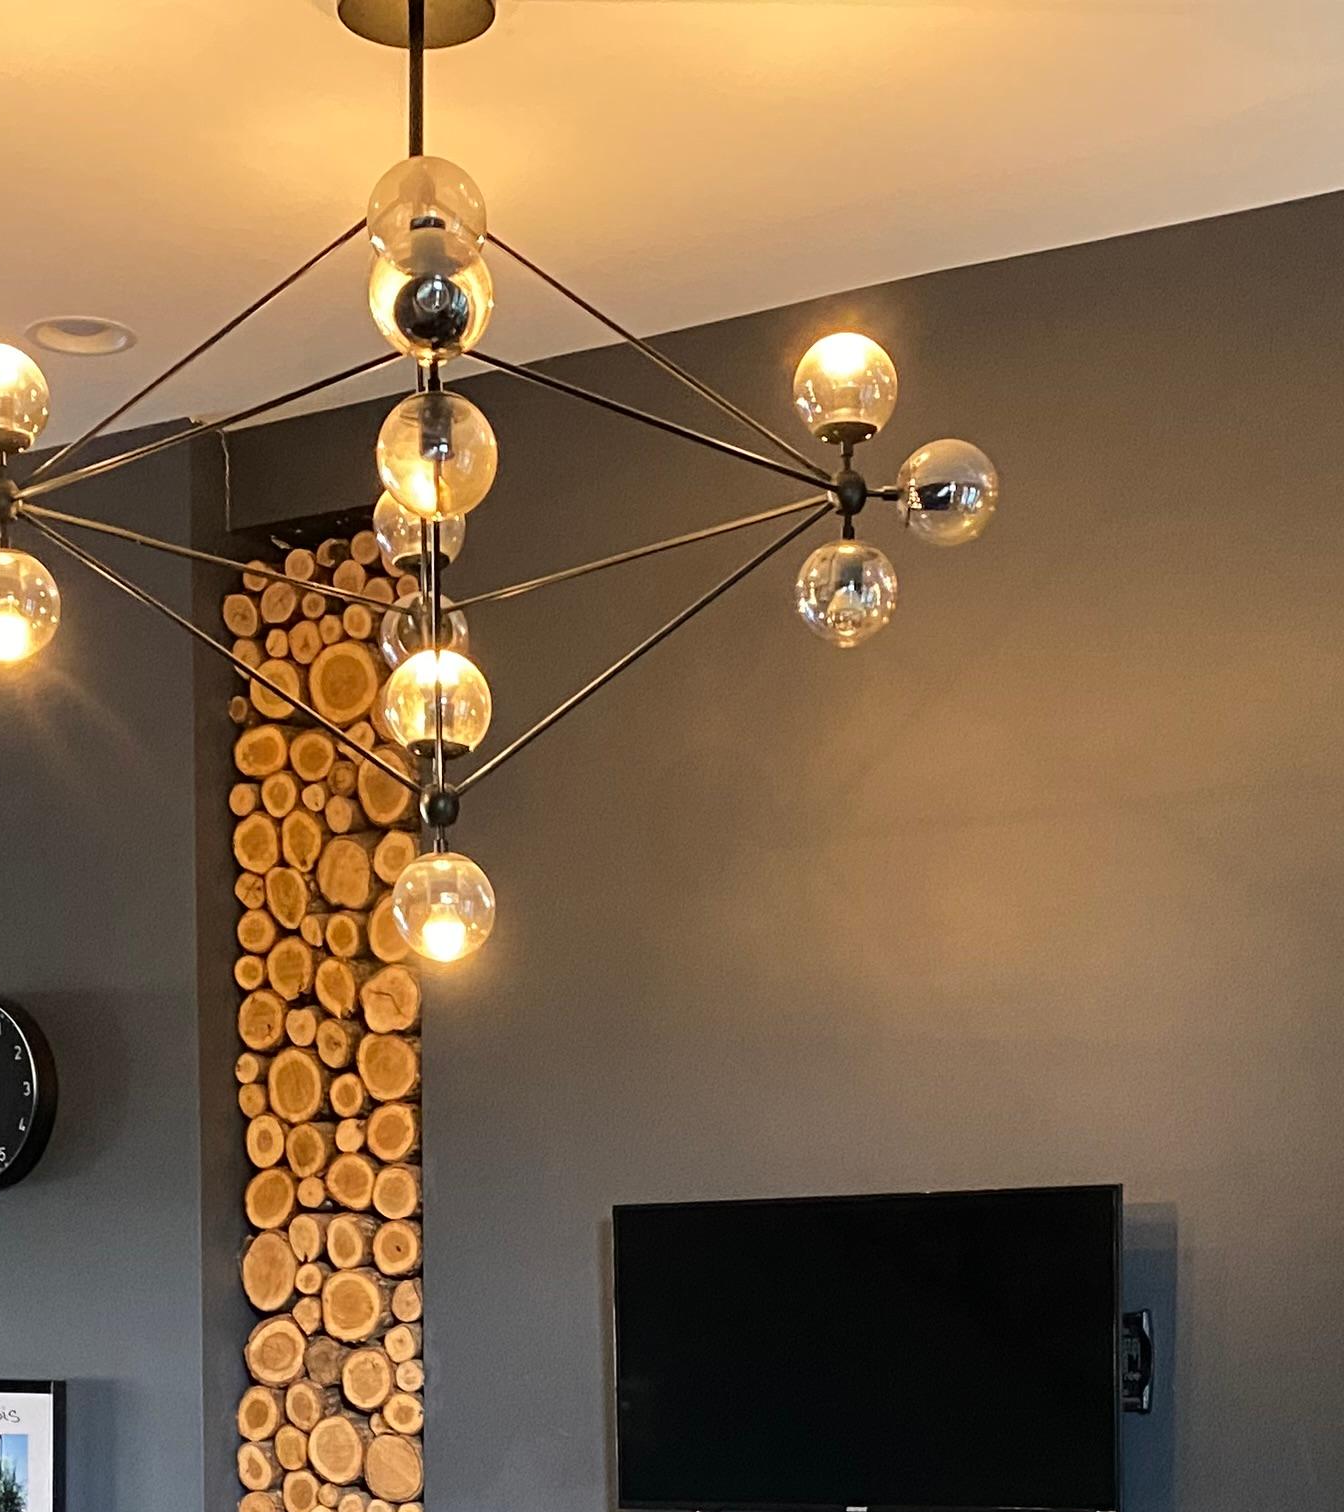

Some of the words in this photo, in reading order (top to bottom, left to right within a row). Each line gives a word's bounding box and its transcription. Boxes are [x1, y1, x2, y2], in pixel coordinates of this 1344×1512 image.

[14, 1045, 22, 1061] 2
[23, 1081, 31, 1096] 3
[18, 1117, 26, 1132] 4
